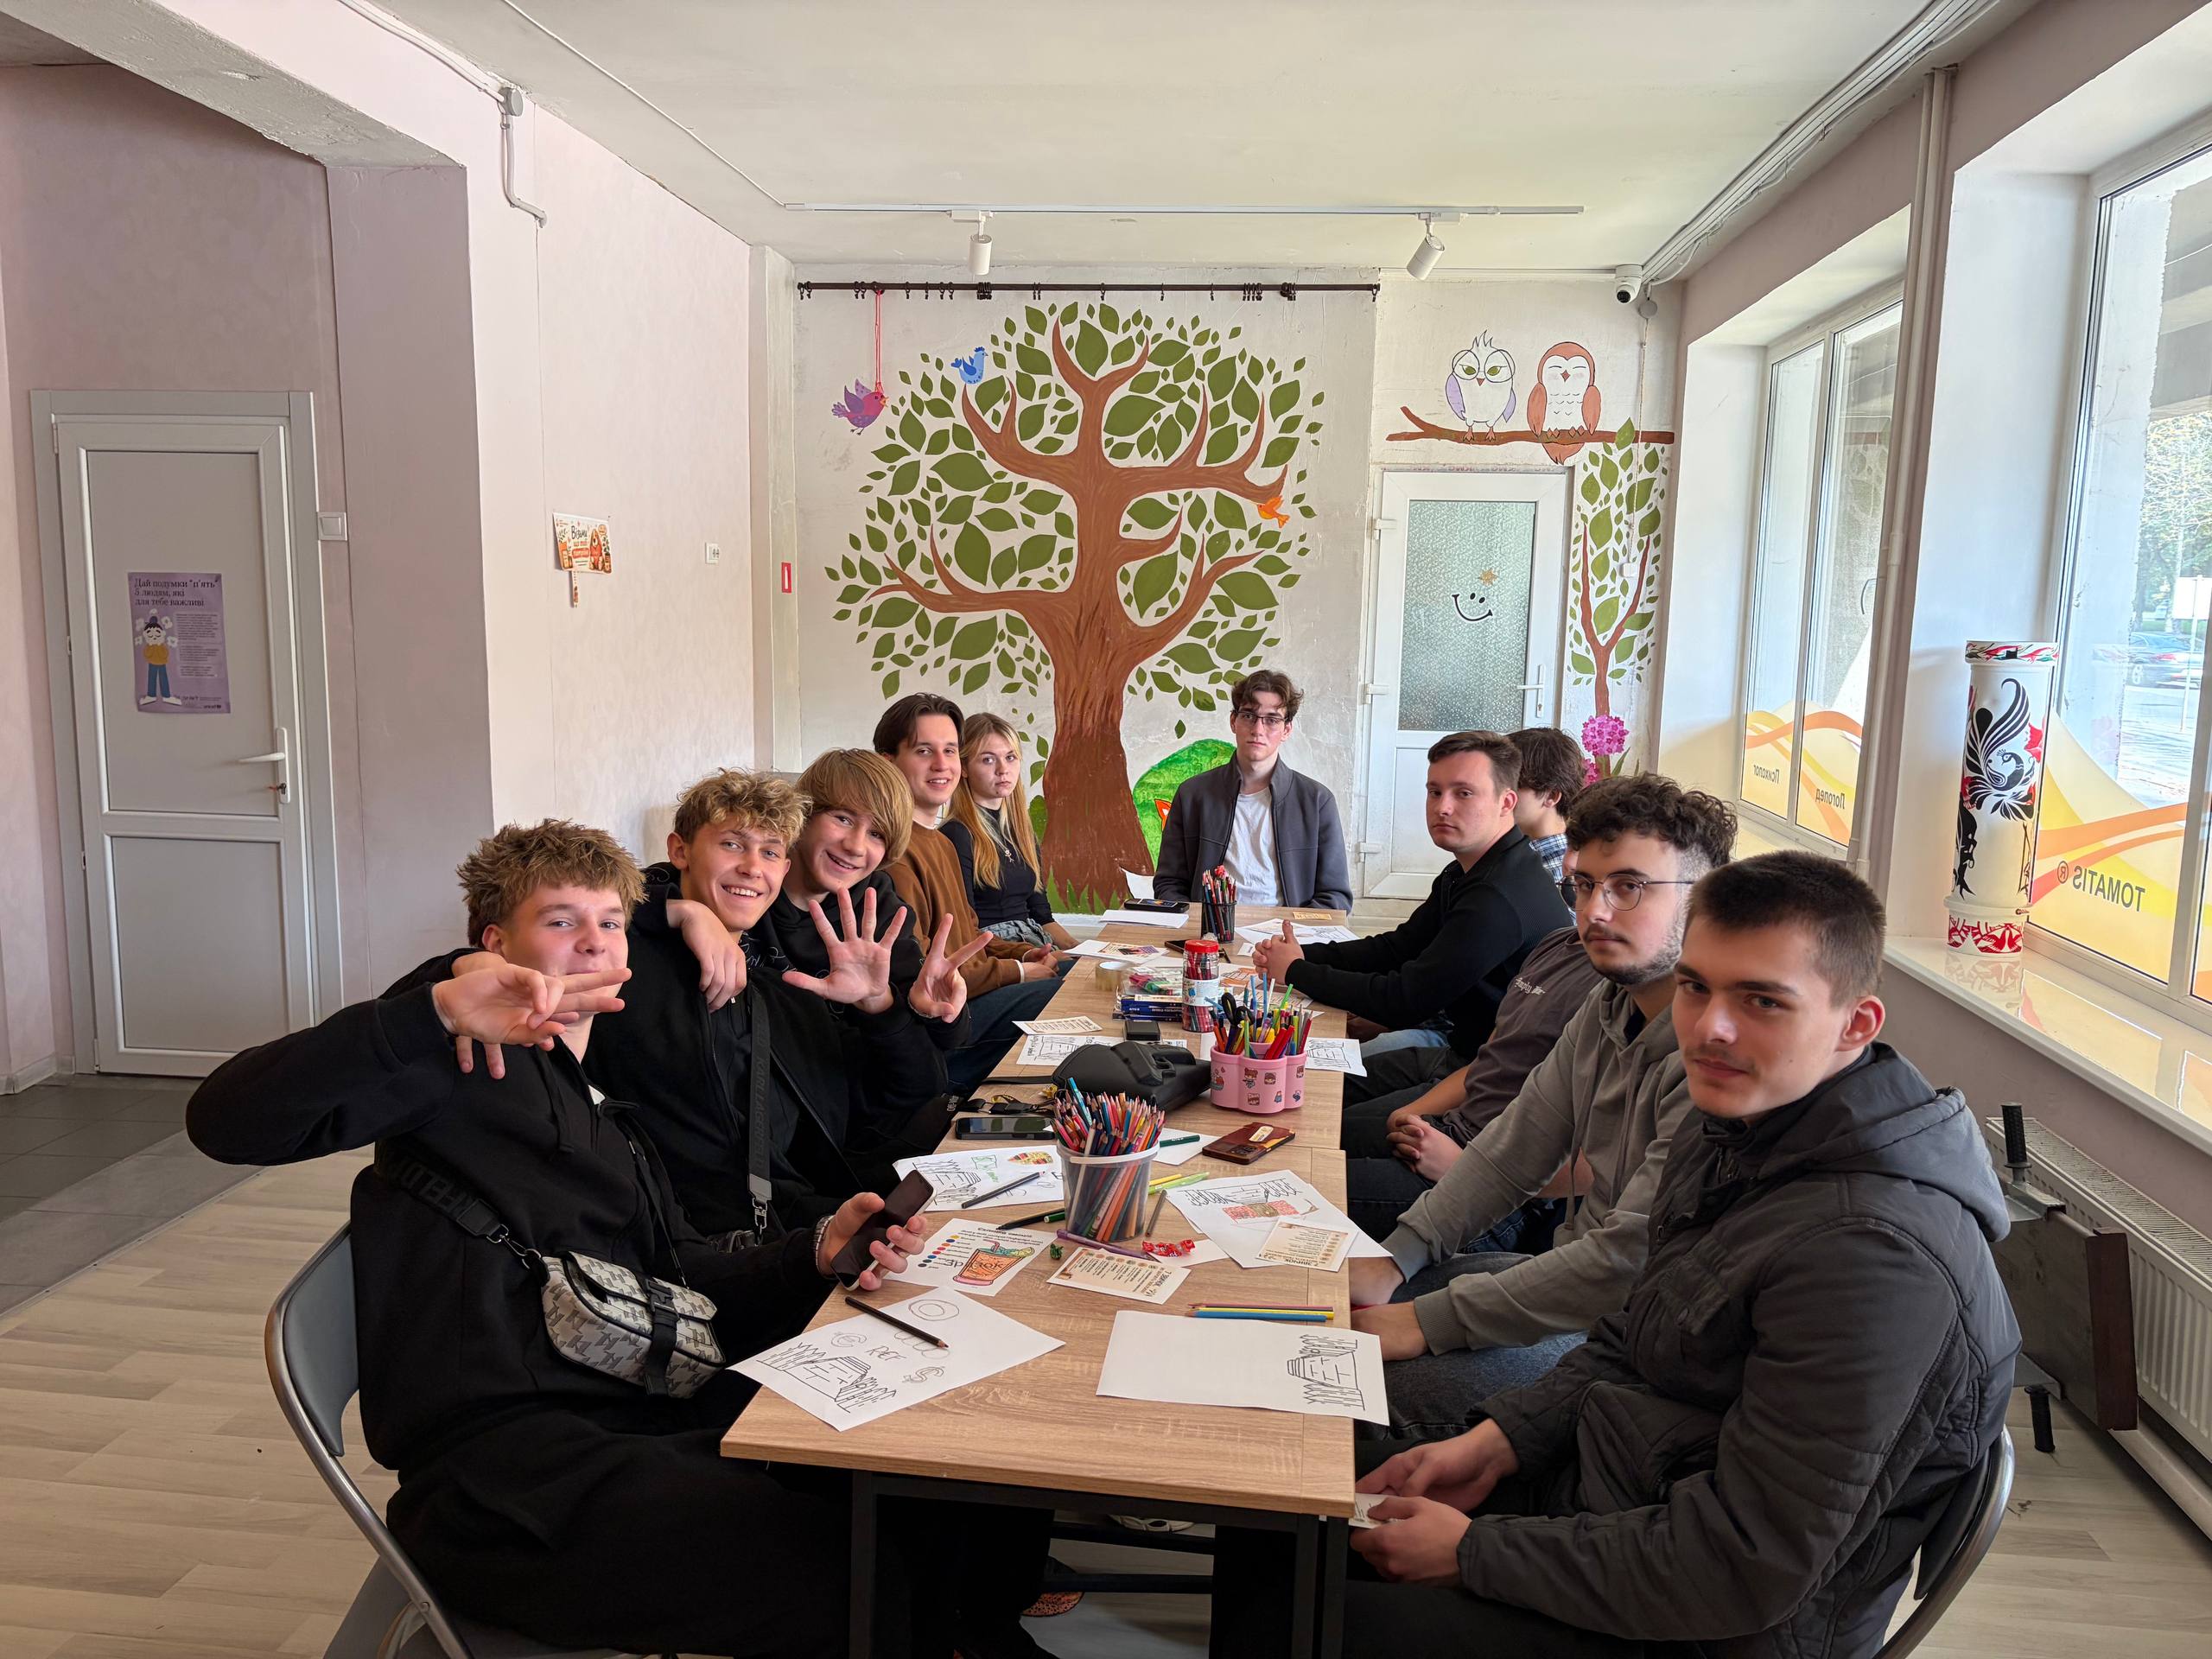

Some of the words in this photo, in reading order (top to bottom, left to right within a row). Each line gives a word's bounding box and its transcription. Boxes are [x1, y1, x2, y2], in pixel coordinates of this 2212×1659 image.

[134, 578, 151, 588] Дай
[153, 581, 188, 589] подумки
[151, 597, 168, 606] тебе
